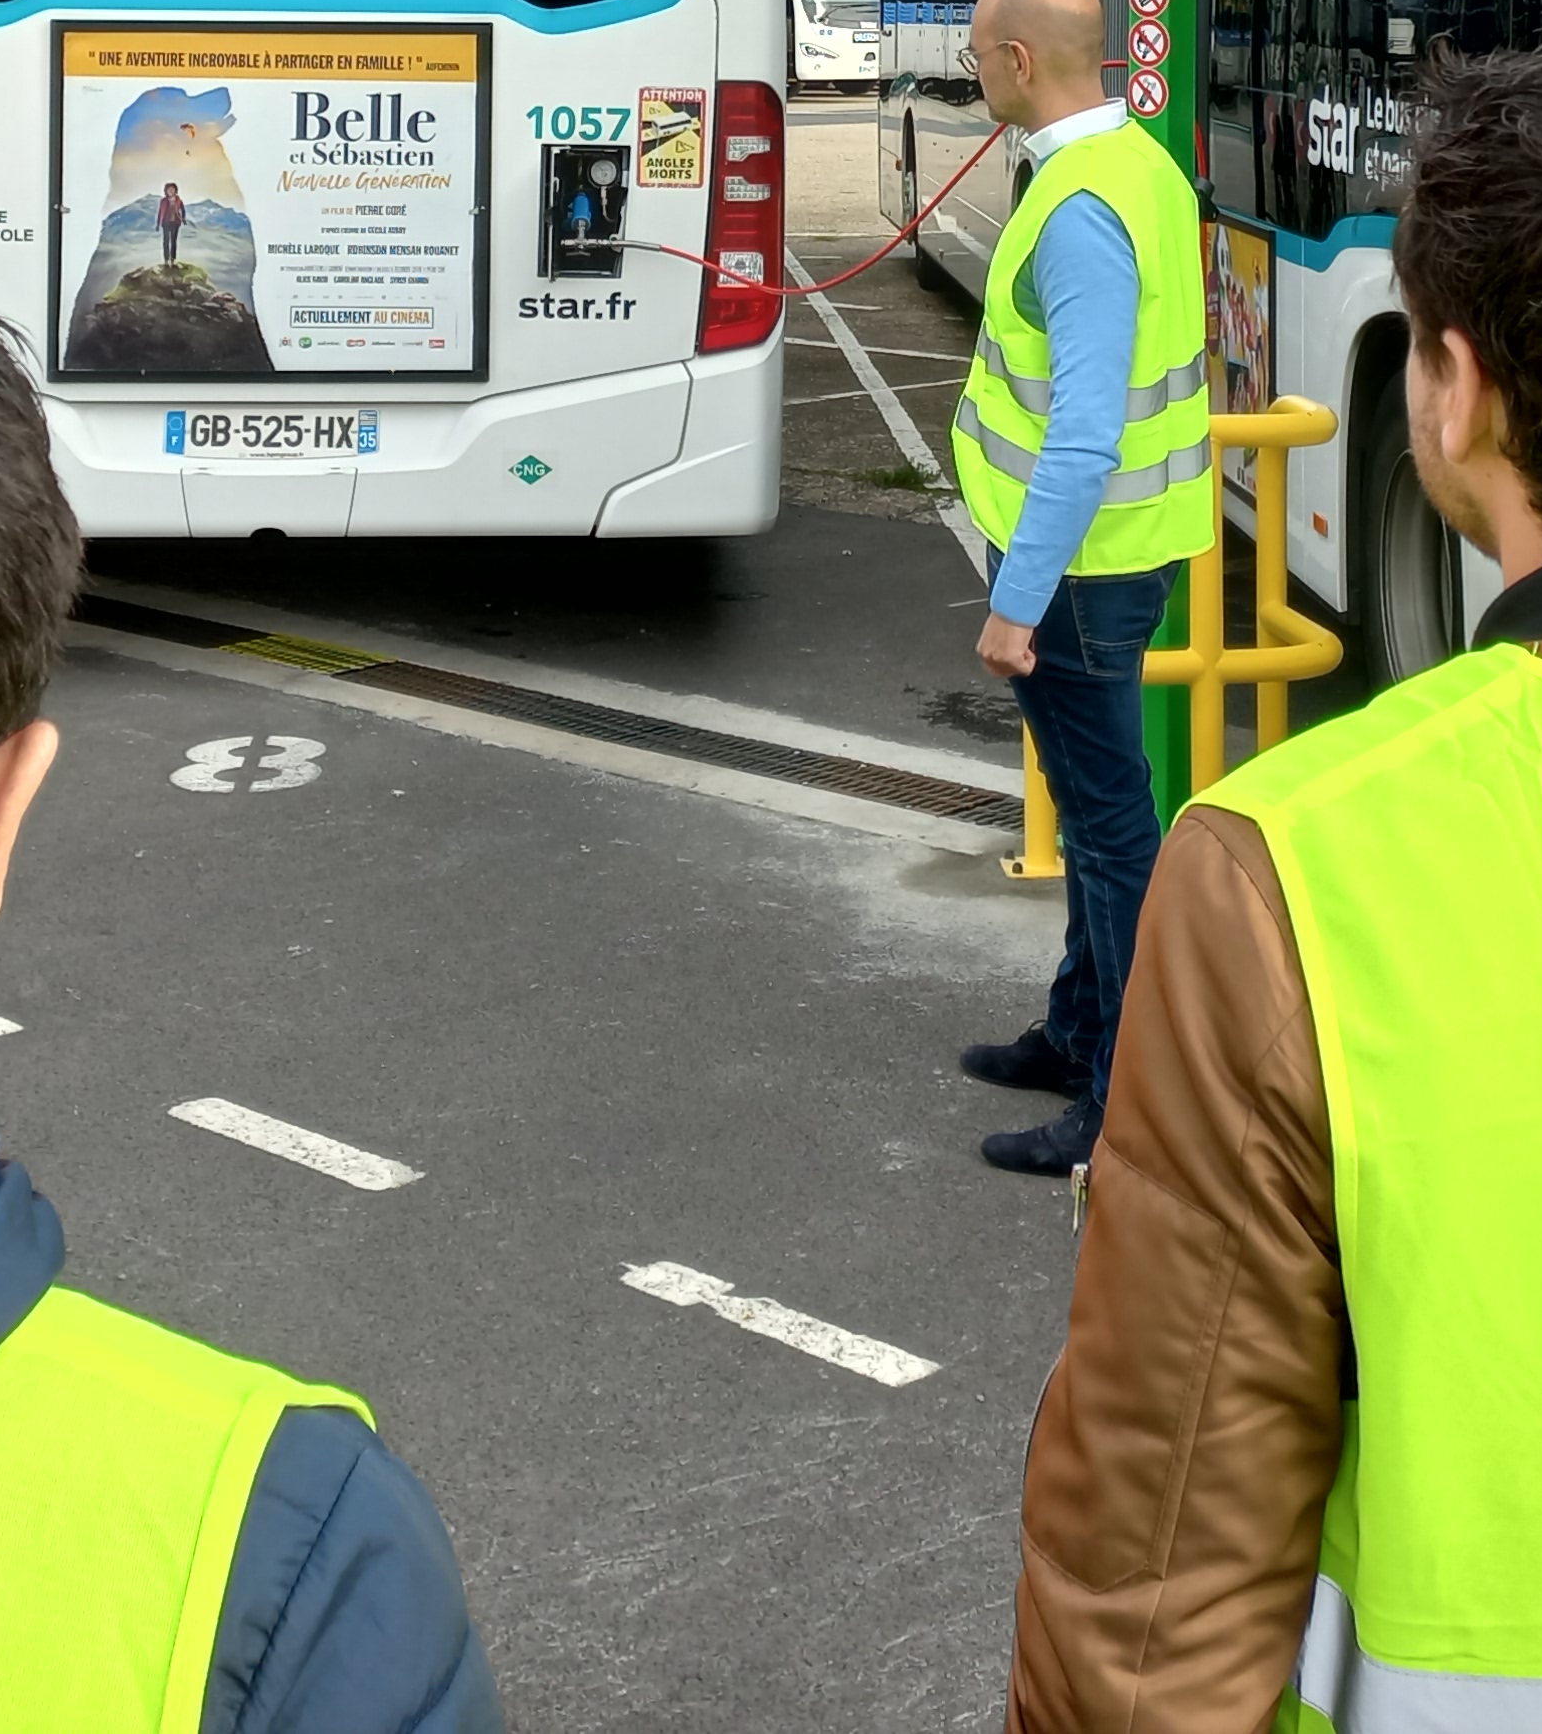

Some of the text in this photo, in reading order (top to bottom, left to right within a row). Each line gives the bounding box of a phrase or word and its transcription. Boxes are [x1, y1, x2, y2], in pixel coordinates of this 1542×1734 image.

[99, 51, 123, 66] UNE
[125, 52, 187, 67] AVENTURE
[189, 52, 260, 68] INCROYABLE
[263, 51, 272, 68] À
[275, 54, 333, 70] PARTAGER
[337, 55, 352, 70] EN
[356, 55, 404, 71] FAMILLE
[642, 89, 703, 100] ATTENTION
[290, 91, 437, 144] Belle
[1366, 86, 1383, 130] Le
[526, 106, 631, 141] 1057
[1307, 84, 1360, 175] star
[289, 142, 435, 166] et Sébastien
[646, 157, 694, 169] ANGLES
[649, 169, 692, 180] MORTS
[268, 243, 302, 254] MICHÈLE
[304, 245, 340, 255] LAROQUE
[518, 292, 637, 319] star.fr
[293, 309, 430, 325] ACTUELLEMENT AU CINÉMA
[172, 436, 178, 446] F
[190, 415, 354, 449] GB-525-HX
[359, 432, 377, 448] 35
[513, 464, 546, 476] CNG
[169, 735, 327, 794] 8
